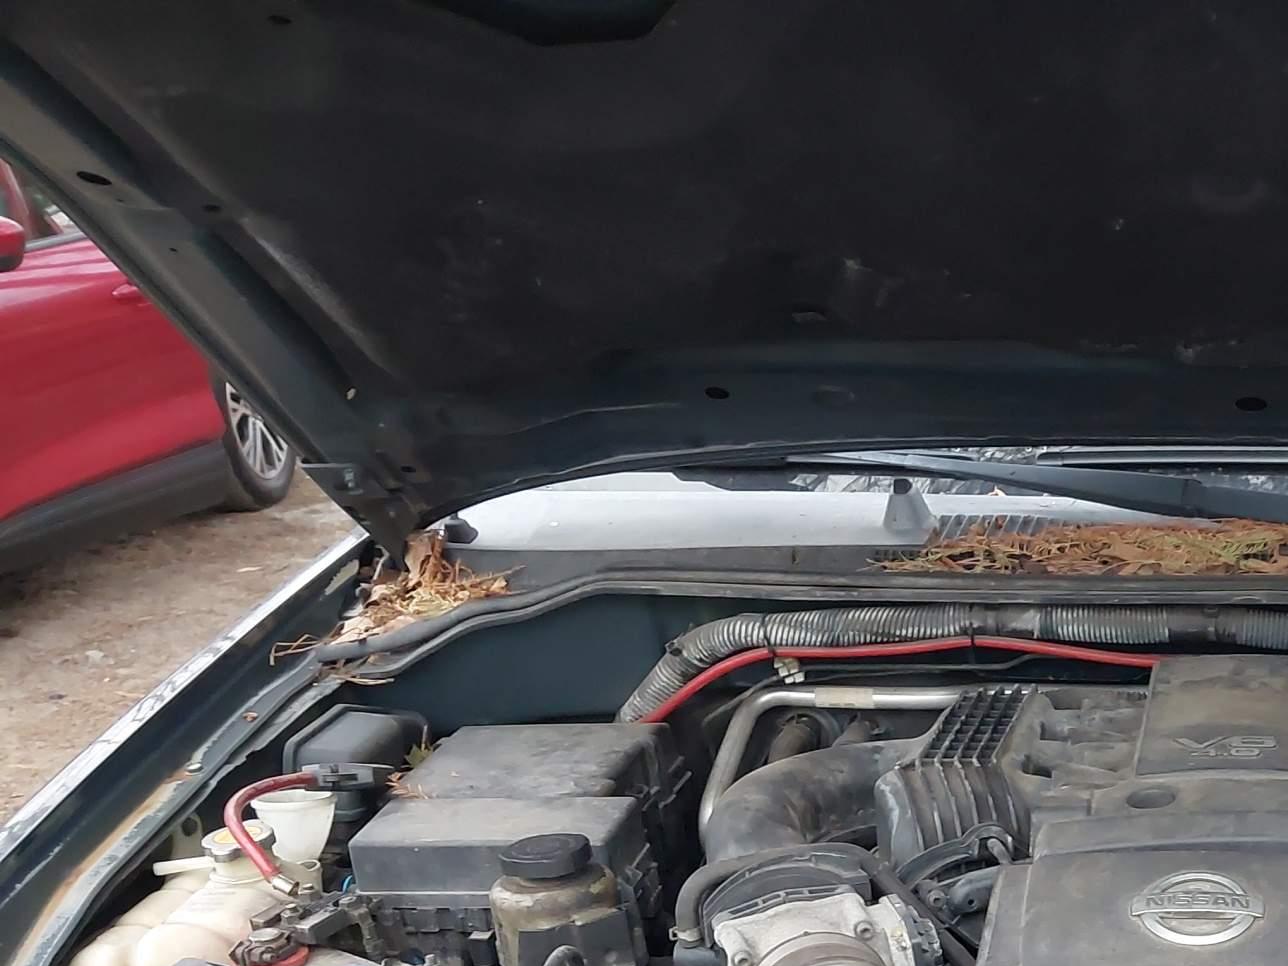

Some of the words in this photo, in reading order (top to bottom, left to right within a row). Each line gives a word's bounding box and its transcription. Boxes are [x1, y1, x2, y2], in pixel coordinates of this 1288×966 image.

[1173, 735, 1279, 750] V6
[1189, 747, 1264, 760] 4.0
[1146, 895, 1250, 909] NISSAN
